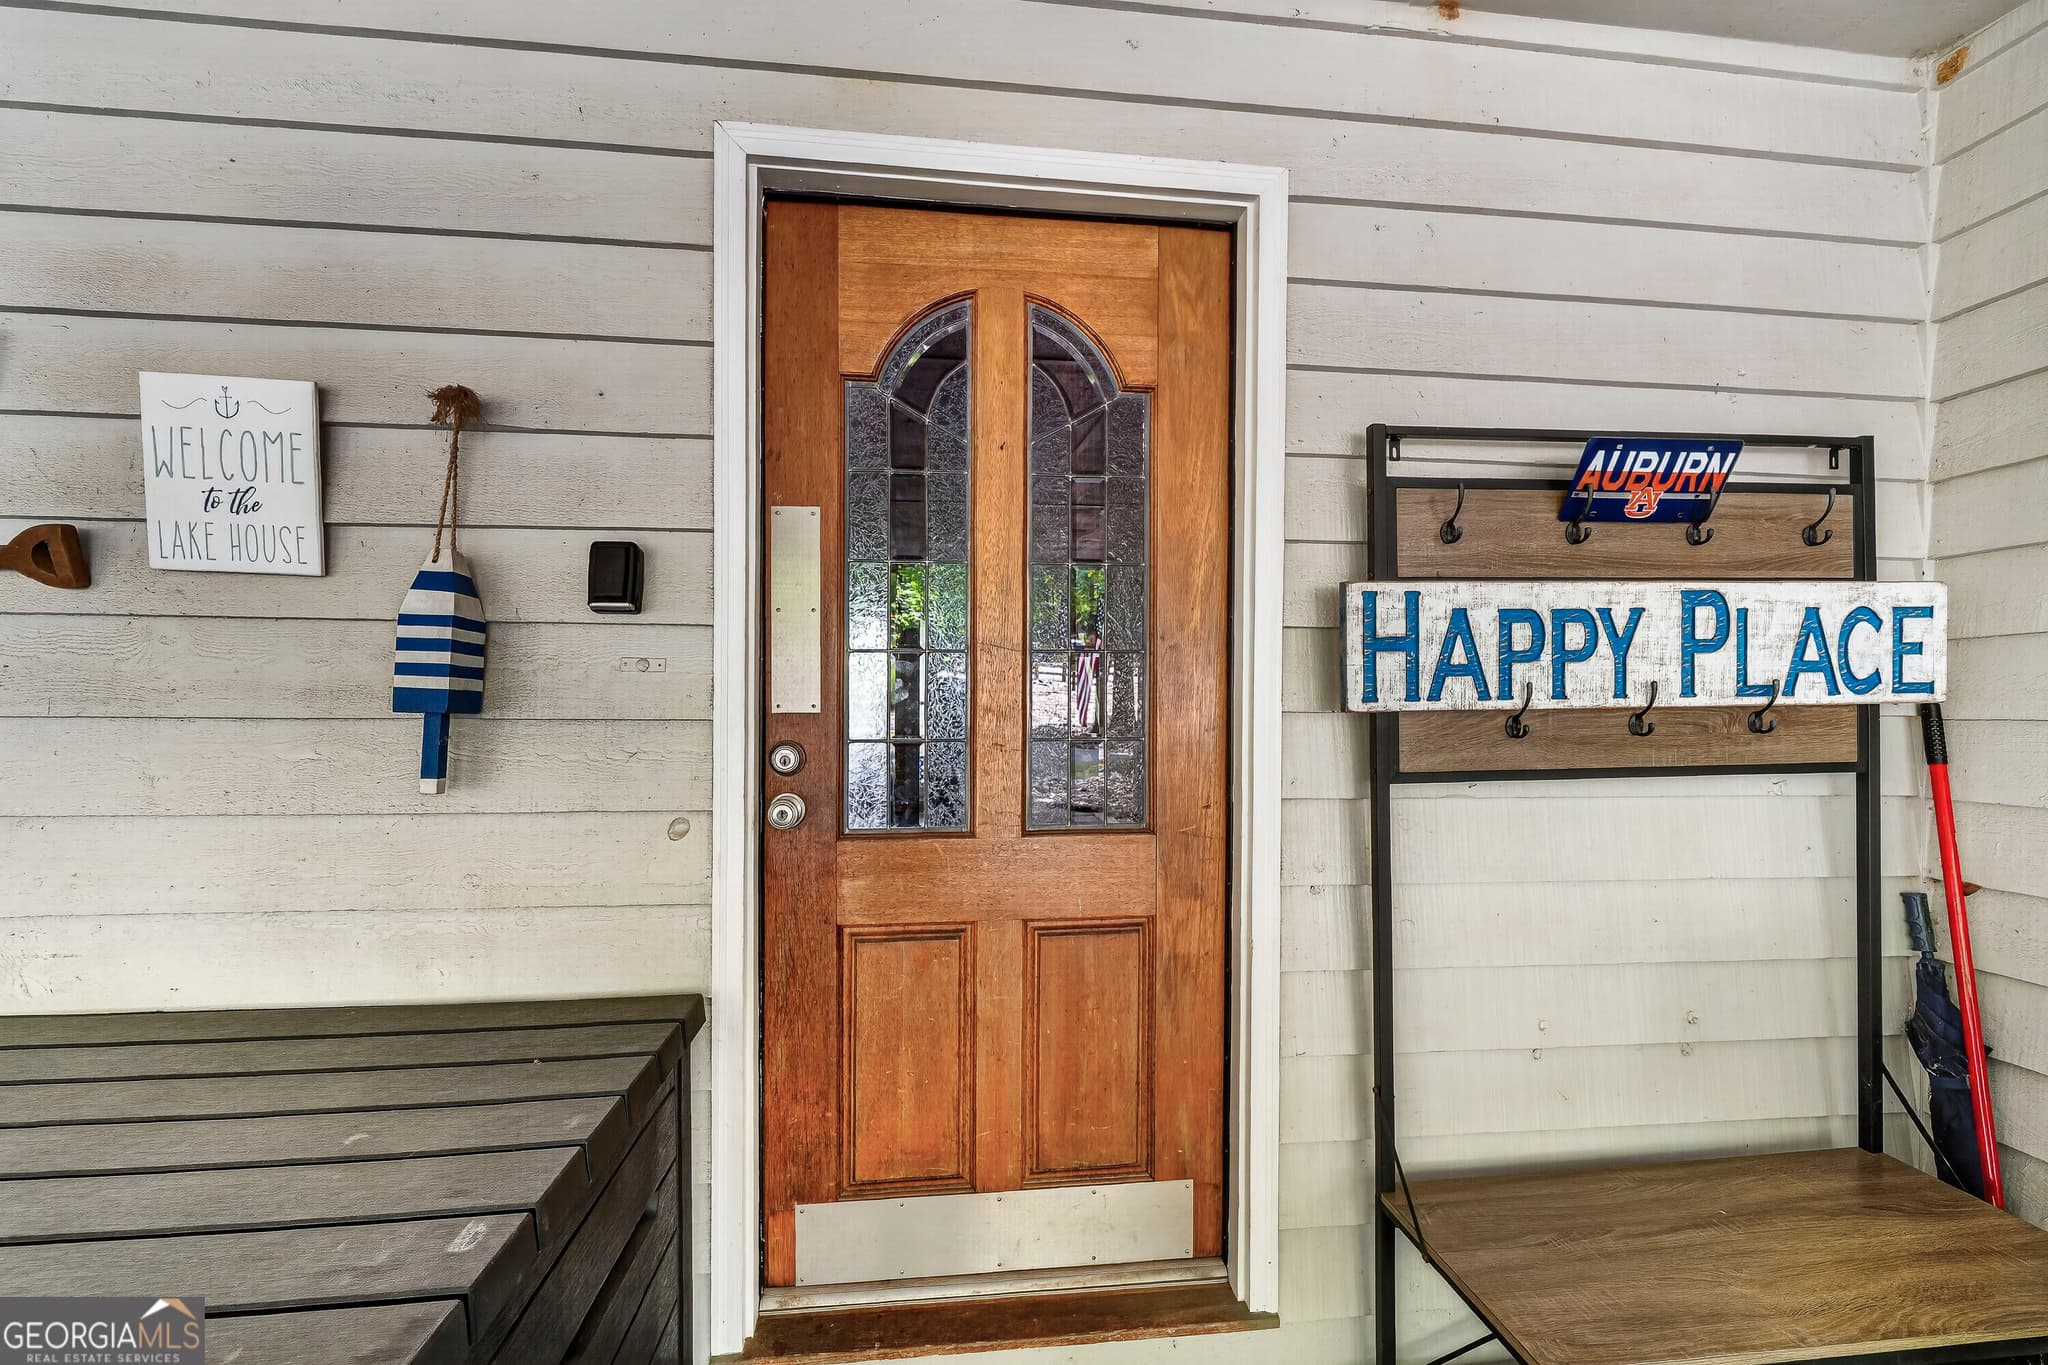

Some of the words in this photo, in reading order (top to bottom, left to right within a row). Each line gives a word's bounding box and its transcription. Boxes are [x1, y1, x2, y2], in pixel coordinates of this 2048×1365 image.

[151, 425, 305, 485] WELCOME
[1575, 450, 1737, 492] AUBURN
[201, 486, 223, 513] to
[227, 486, 263, 515] the
[157, 520, 217, 561] LAKE
[230, 523, 308, 565] HOUSE
[1361, 590, 1646, 703] HAPPY
[1680, 589, 1935, 698] PLACE
